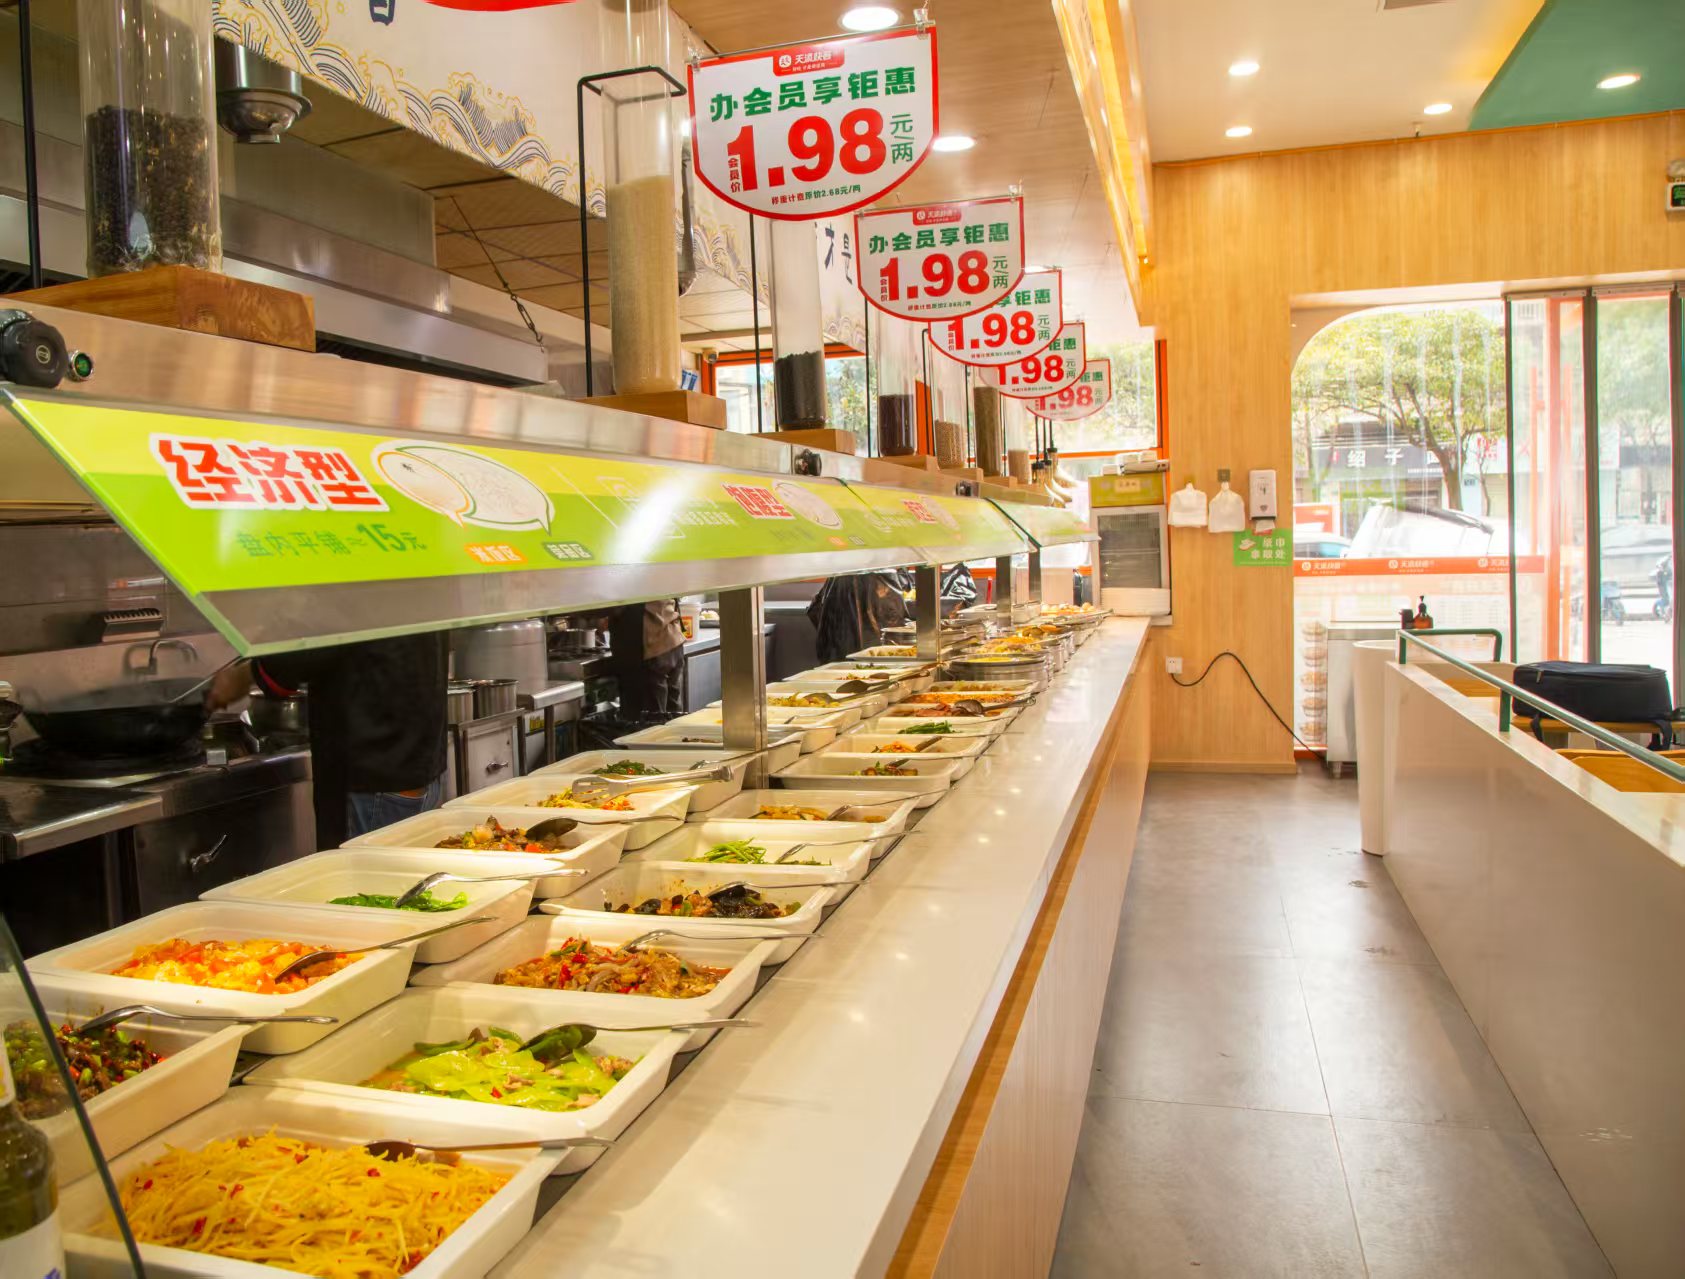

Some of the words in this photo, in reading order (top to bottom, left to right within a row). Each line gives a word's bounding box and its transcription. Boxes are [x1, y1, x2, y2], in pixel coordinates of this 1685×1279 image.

[710, 67, 916, 122] 办会员享钜惠
[727, 108, 887, 192] 1.98
[869, 223, 1010, 255] 办会员享钜惠
[880, 250, 990, 301] 1.98
[948, 310, 1036, 350] 1.98
[998, 354, 1064, 385] 1.98
[158, 440, 384, 512] 经济型
